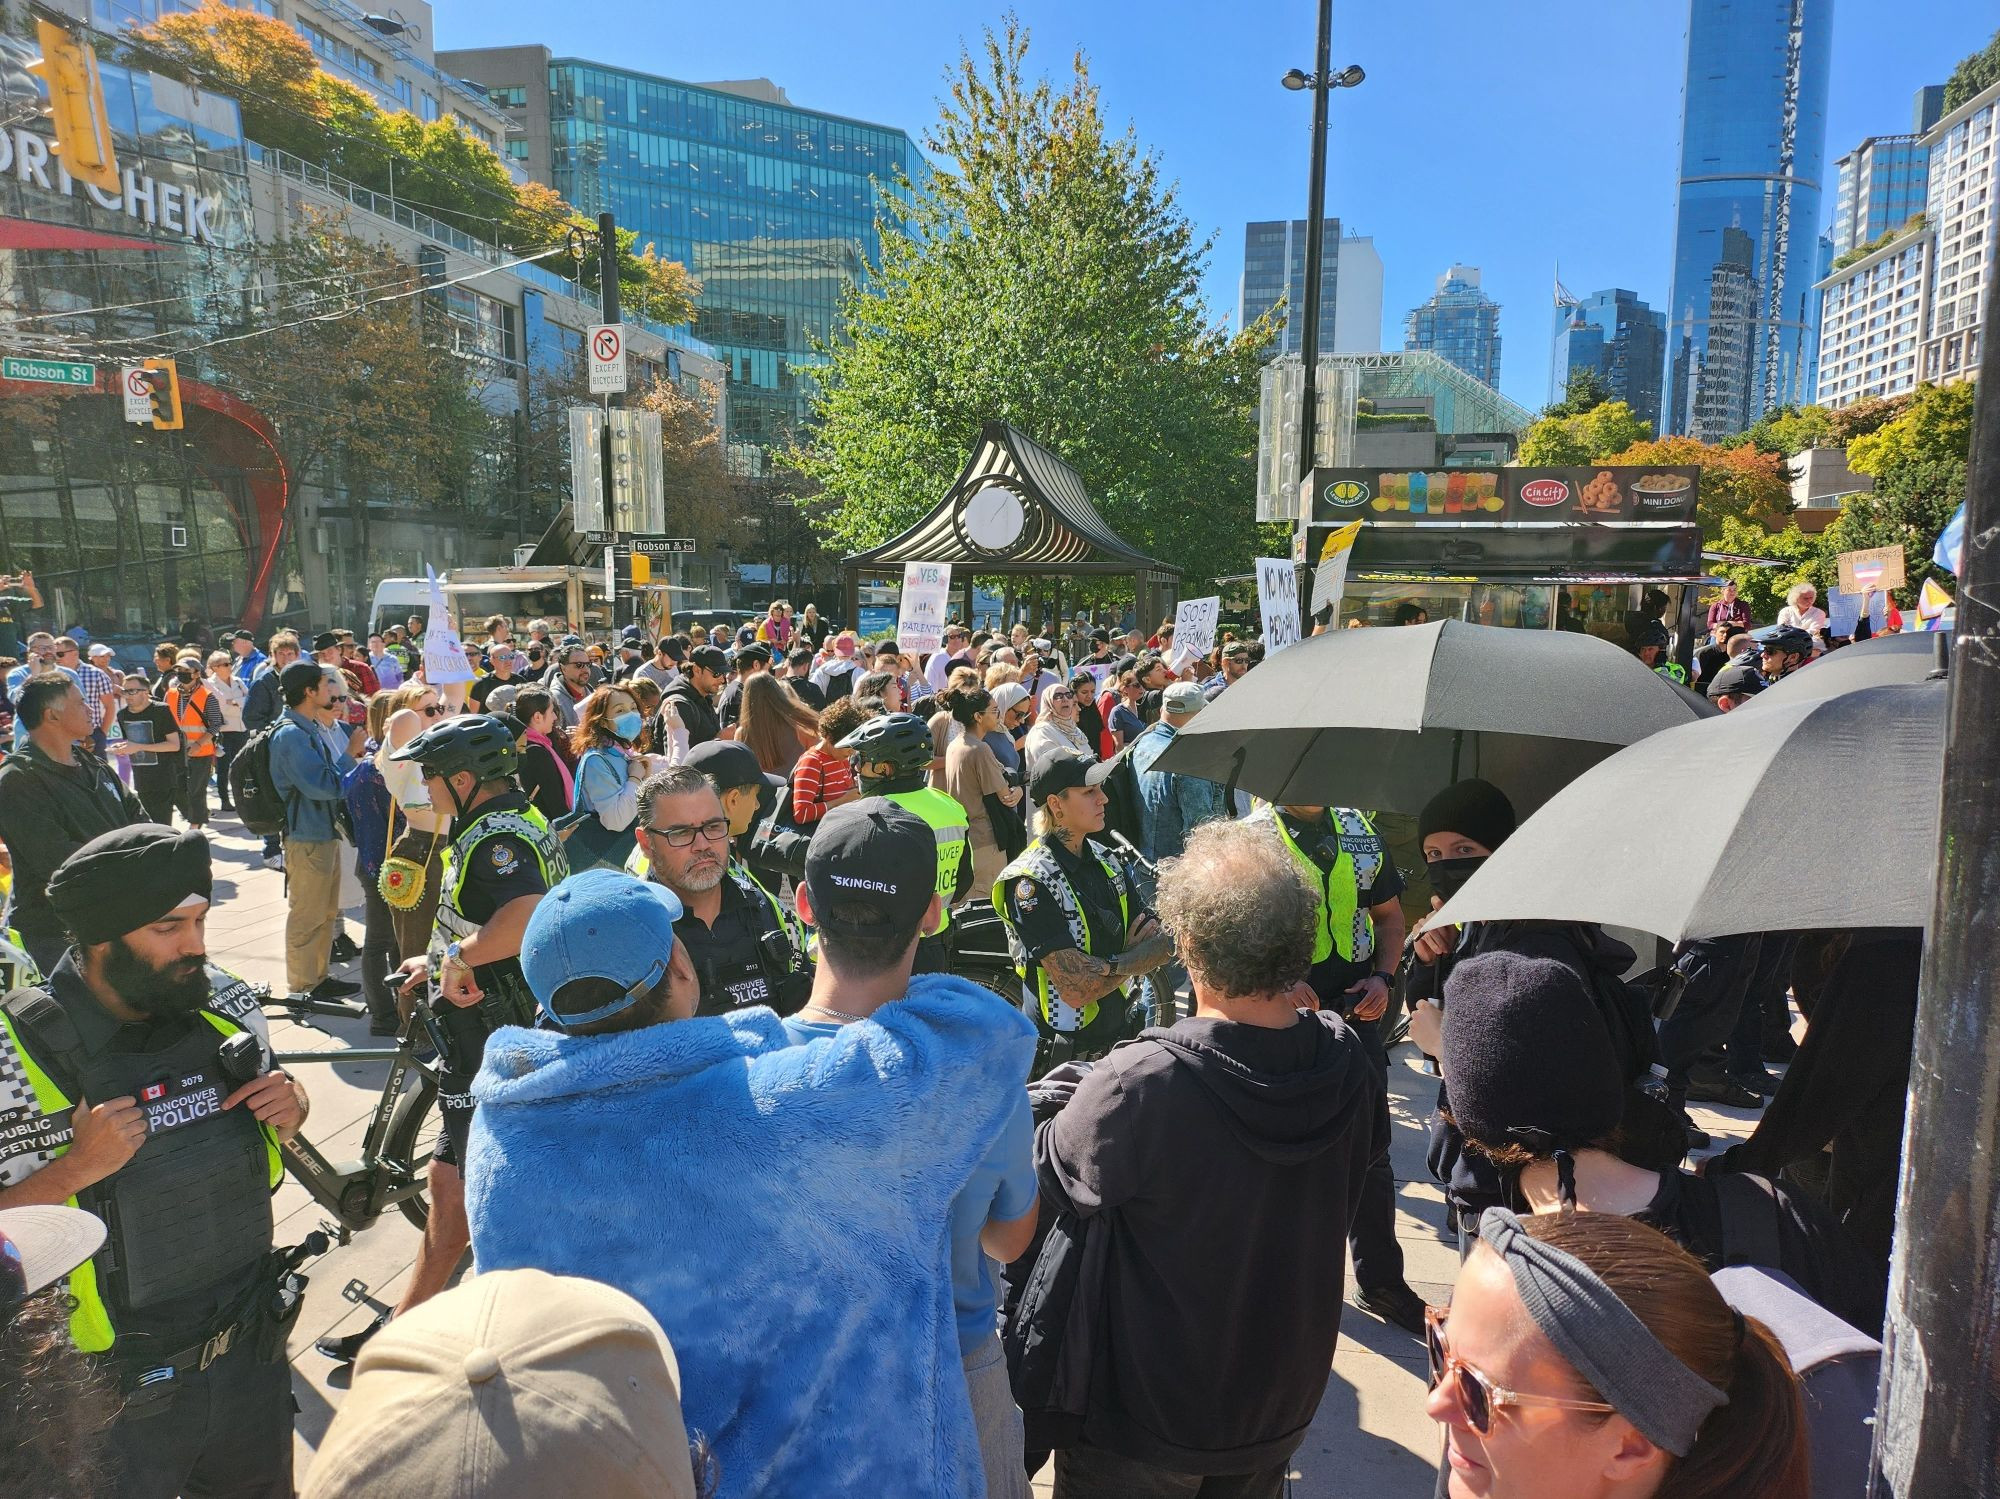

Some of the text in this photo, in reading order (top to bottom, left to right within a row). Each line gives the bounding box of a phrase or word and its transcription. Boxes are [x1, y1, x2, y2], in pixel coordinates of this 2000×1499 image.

[10, 362, 88, 382] Robson St
[595, 363, 619, 373] EXCEPT
[592, 375, 624, 385] BICYCLES
[1526, 486, 1564, 500] Cin City
[637, 541, 670, 551] Robson
[920, 567, 938, 584] YES
[1264, 566, 1276, 600] NO
[1889, 578, 1905, 588] DIE
[1181, 602, 1213, 623] SOGI
[1341, 842, 1381, 853] POLICE
[835, 876, 897, 894] SKINGIRLS
[181, 1074, 203, 1087] 3079
[147, 1087, 217, 1116] VANCOUVER
[381, 1068, 405, 1122] POLICE
[149, 1096, 221, 1133] POLICE
[285, 1138, 324, 1176] CUBE
